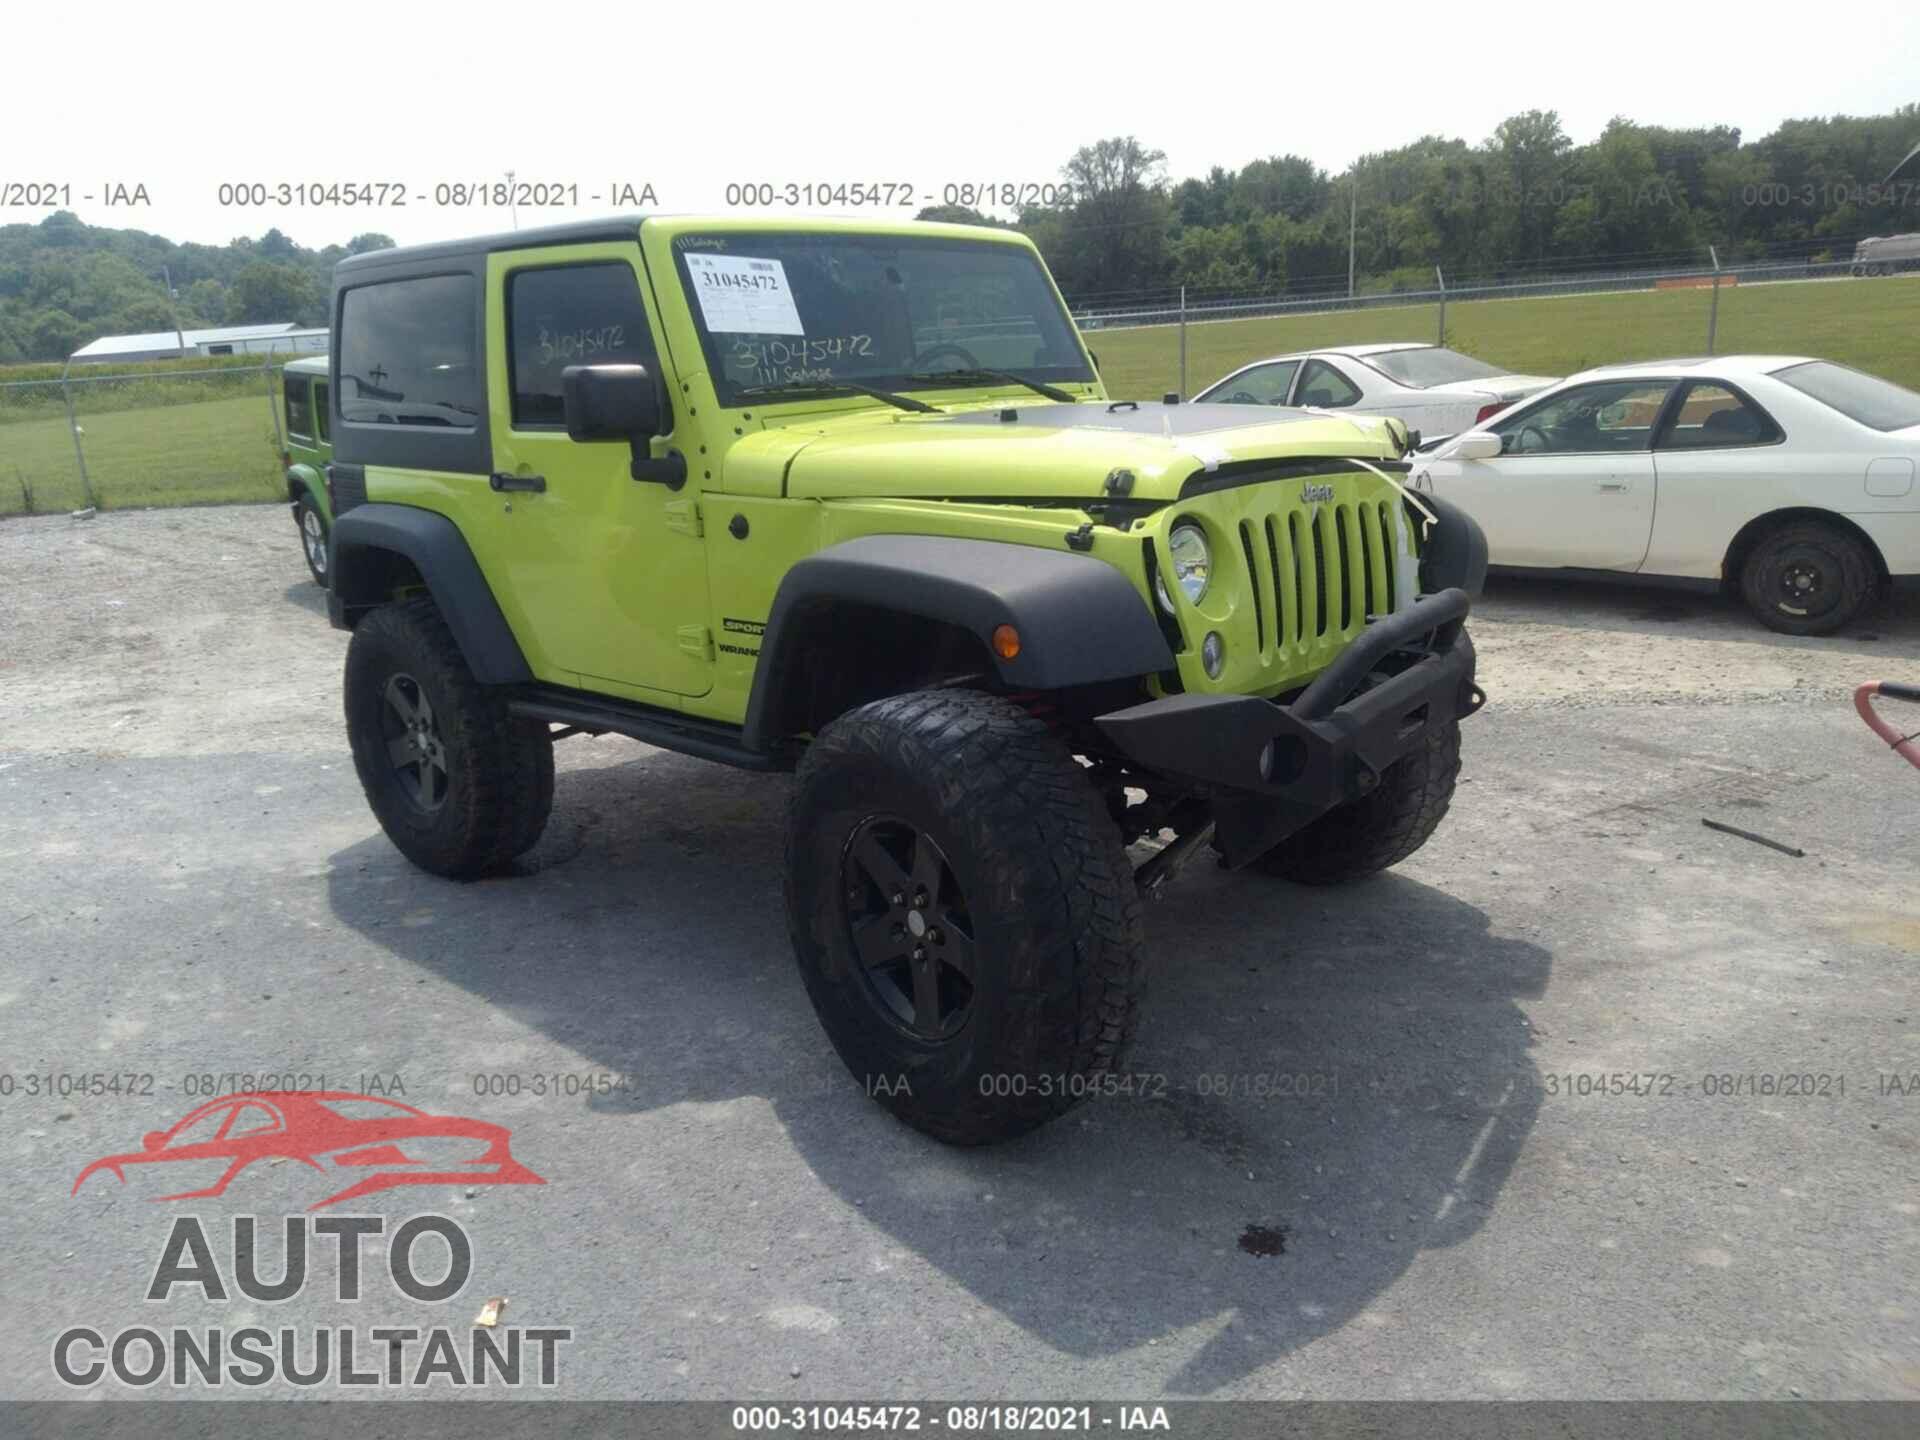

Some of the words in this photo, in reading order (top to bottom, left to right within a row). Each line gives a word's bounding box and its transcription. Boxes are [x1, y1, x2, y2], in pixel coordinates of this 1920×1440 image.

[702, 271, 779, 291] 31045472
[732, 333, 875, 369] 31045472
[1301, 481, 1334, 503] Jeep
